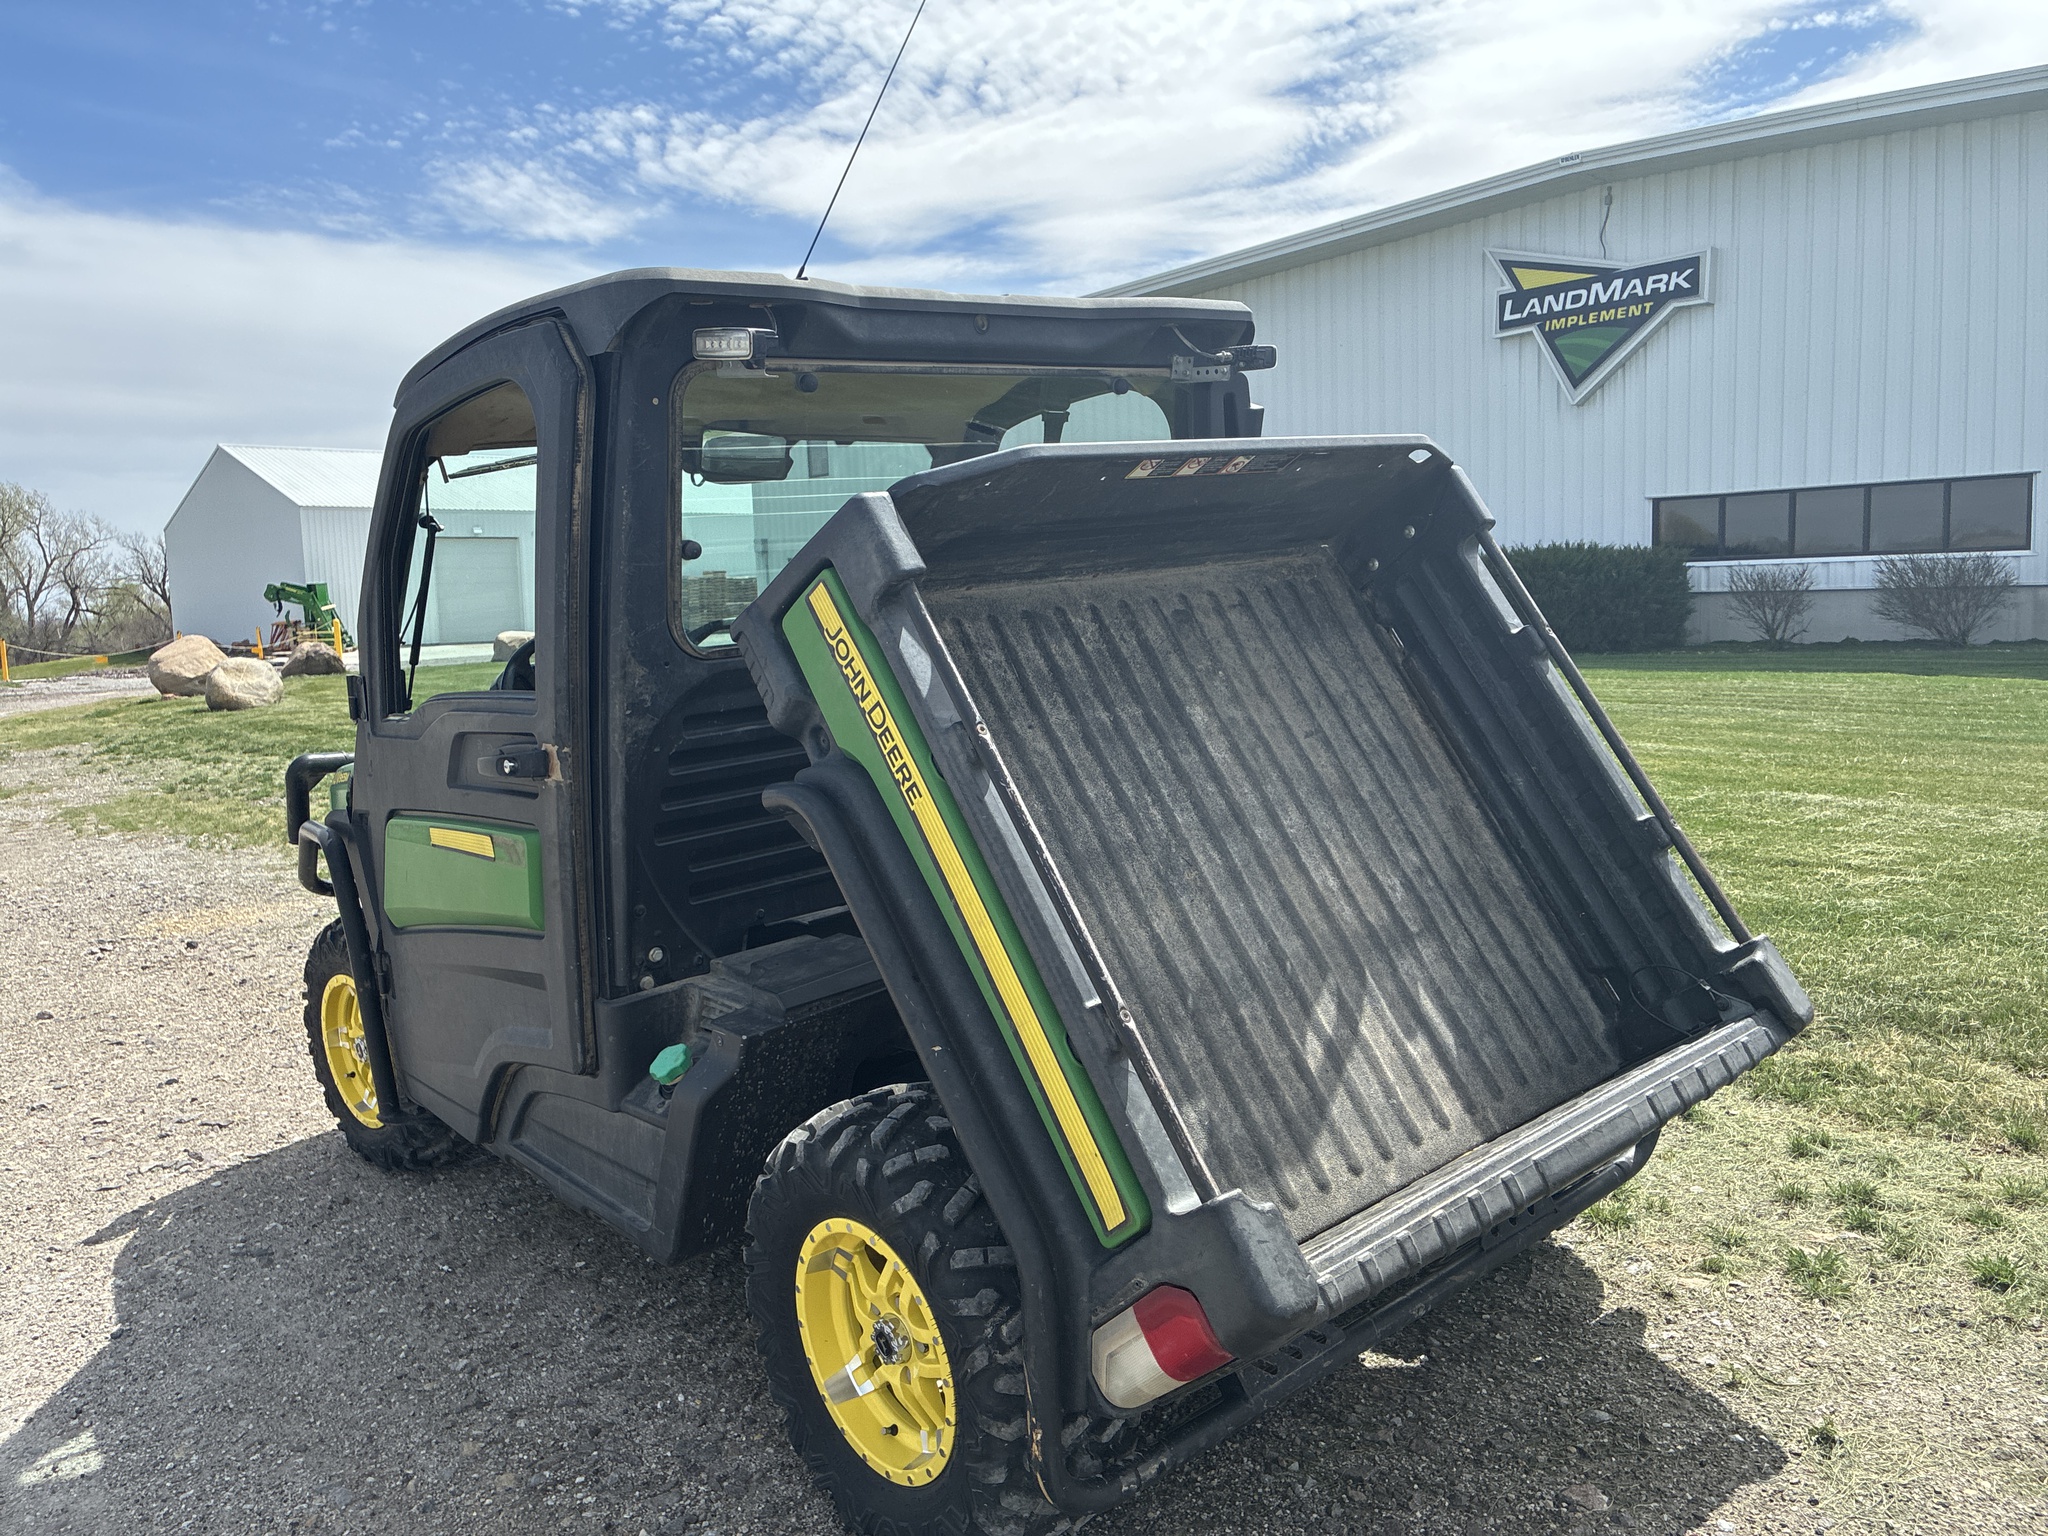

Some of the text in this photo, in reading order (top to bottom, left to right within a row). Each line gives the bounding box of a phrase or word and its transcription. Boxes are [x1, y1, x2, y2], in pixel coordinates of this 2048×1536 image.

[1545, 302, 1654, 332] IMPLEMENT
[825, 626, 923, 806] JOHN DEERE
